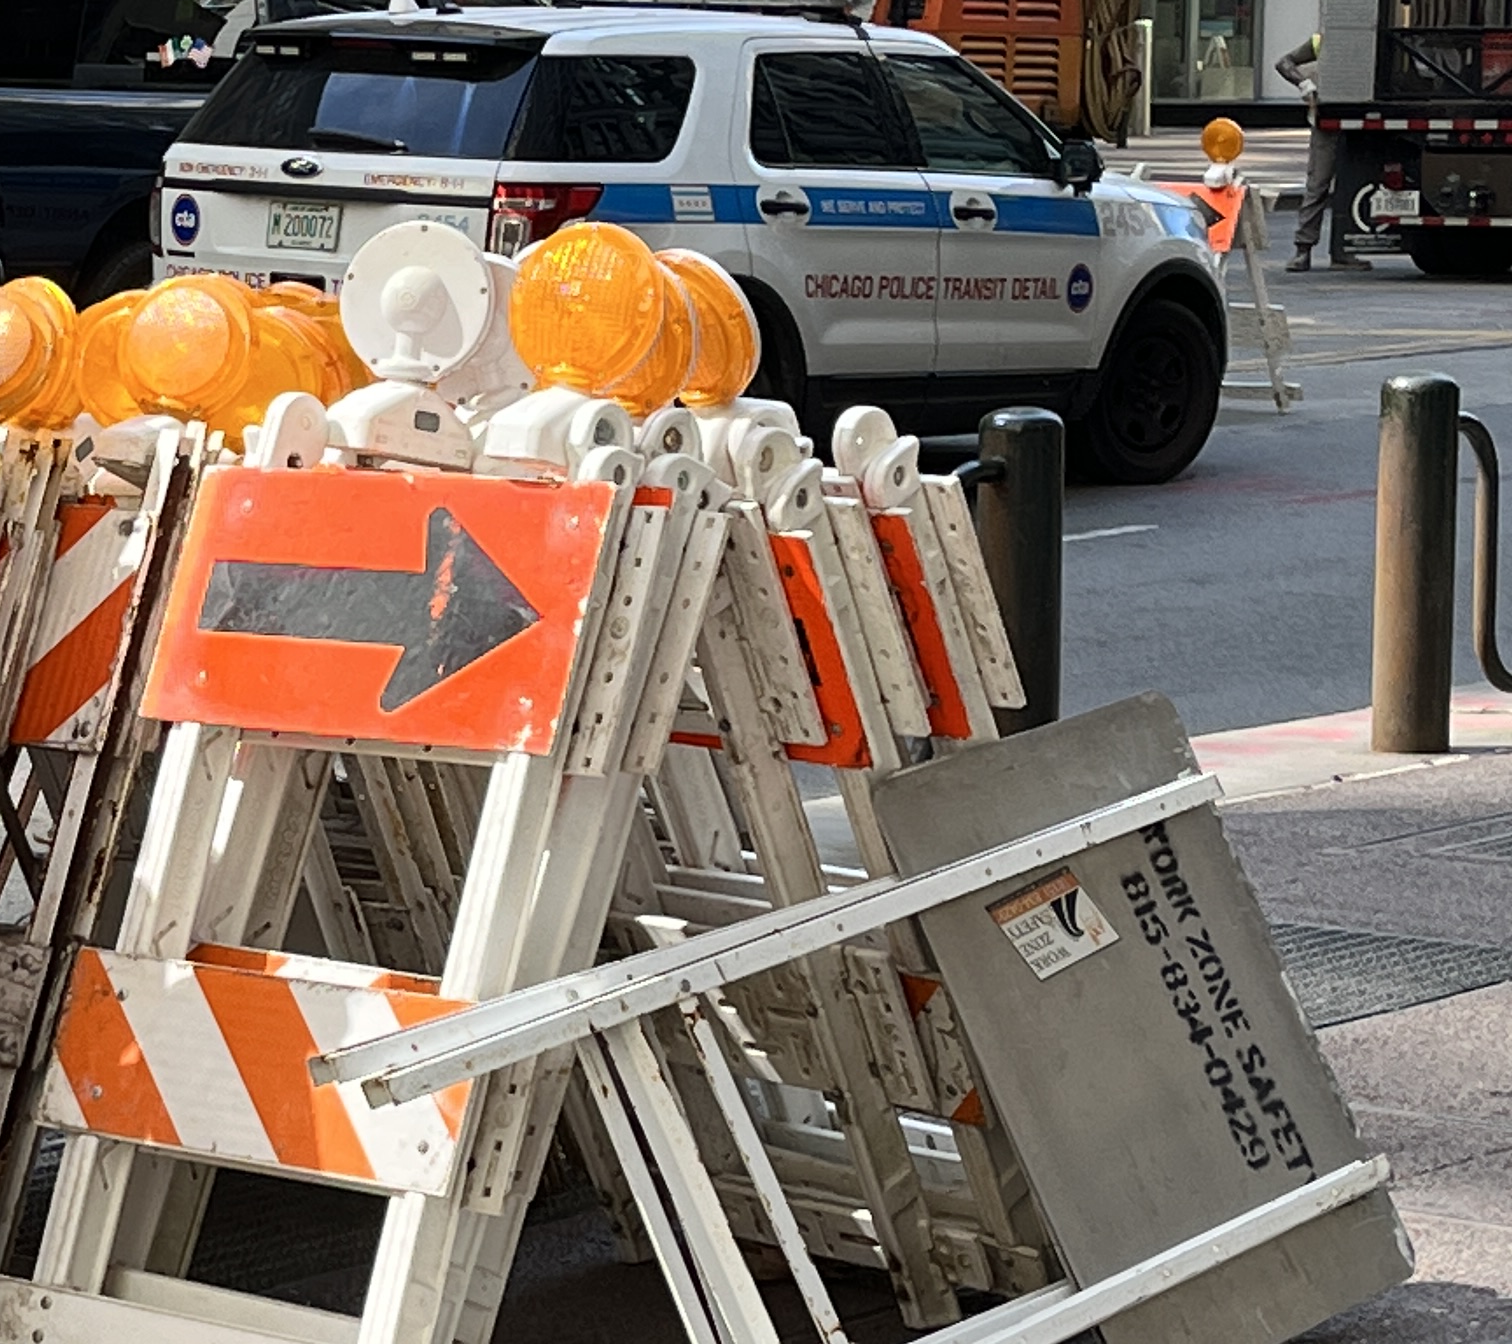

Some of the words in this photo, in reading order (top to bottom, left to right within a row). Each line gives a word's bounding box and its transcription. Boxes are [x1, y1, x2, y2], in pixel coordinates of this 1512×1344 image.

[805, 274, 874, 299] CHICAGO
[878, 275, 936, 300] POLICE
[943, 277, 1007, 301] TRANSIT
[1011, 277, 1061, 301] DETAIL
[1120, 871, 1270, 1171] 815-834-0429
[1186, 927, 1252, 1038] ZONE
[1236, 1044, 1317, 1185] SAFET
